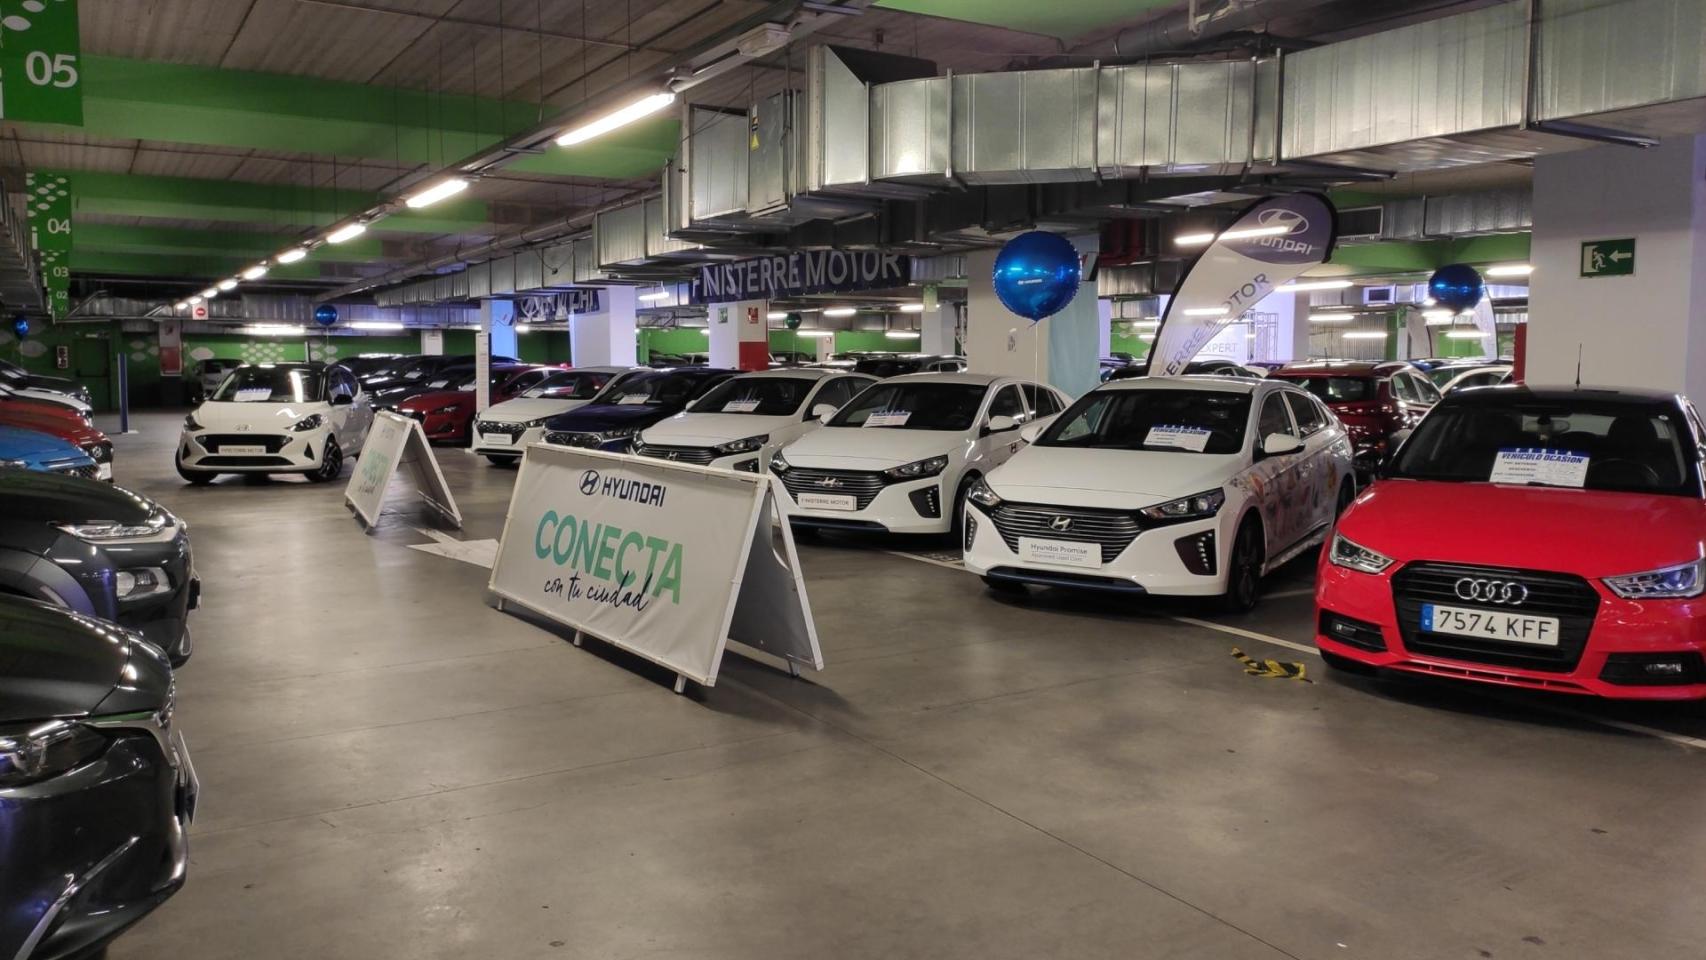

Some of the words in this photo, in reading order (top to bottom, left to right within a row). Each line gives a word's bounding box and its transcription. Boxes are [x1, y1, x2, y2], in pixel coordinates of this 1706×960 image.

[26, 50, 78, 88] 05
[47, 218, 71, 234] 04
[53, 266, 69, 278] 03
[805, 249, 900, 286] MOTOR
[56, 290, 68, 300] 02
[601, 476, 666, 507] HYUNDAI
[535, 510, 683, 605] CONECTA
[1031, 543, 1059, 552] Hyundai
[1060, 546, 1088, 555] Promise
[544, 577, 564, 598] con
[567, 571, 583, 602] tu
[586, 570, 653, 612] ciudad
[1439, 610, 1497, 634] 7574
[1506, 617, 1552, 640] KFF
